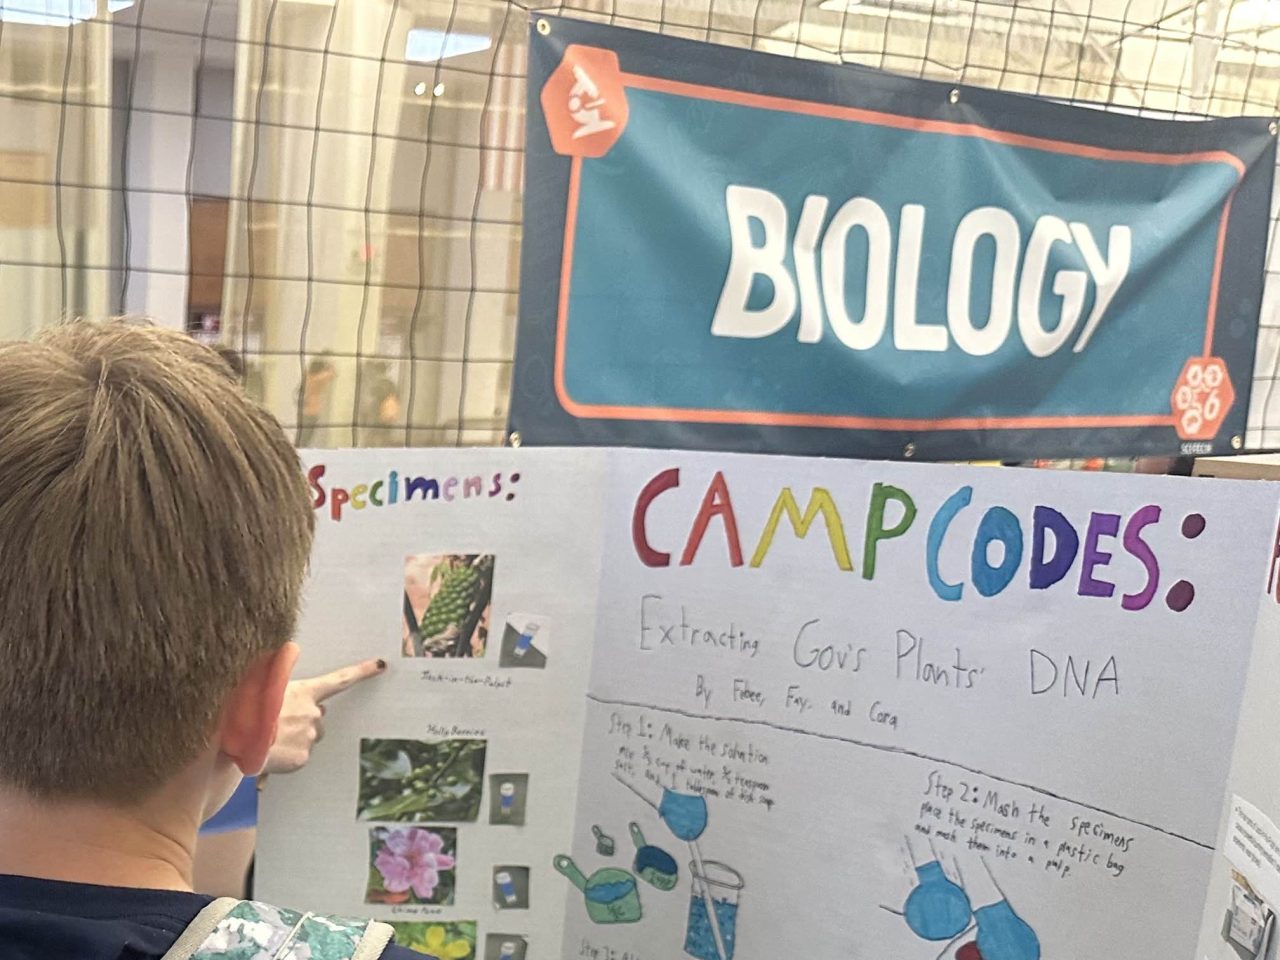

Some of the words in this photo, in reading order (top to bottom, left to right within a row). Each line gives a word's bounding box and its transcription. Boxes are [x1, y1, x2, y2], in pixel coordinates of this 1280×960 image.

[711, 184, 1131, 358] BIOLOGY
[308, 464, 520, 522] Specimens:
[632, 468, 917, 580] CAMP
[926, 486, 1206, 612] CODES:
[640, 594, 761, 658] Extracting
[1030, 649, 1119, 699] DNA
[695, 674, 712, 709] By
[830, 699, 851, 717] and
[658, 722, 691, 751] Make
[698, 735, 717, 757] the
[924, 770, 954, 800] Step
[960, 782, 979, 803] 2:
[982, 790, 1020, 819] Mash
[1028, 803, 1051, 828] the
[1070, 815, 1135, 853] specimens
[949, 807, 966, 828] the
[970, 816, 1019, 841] specimens
[1024, 832, 1036, 847] in
[1057, 840, 1101, 866] plastic
[1105, 853, 1125, 878] bag
